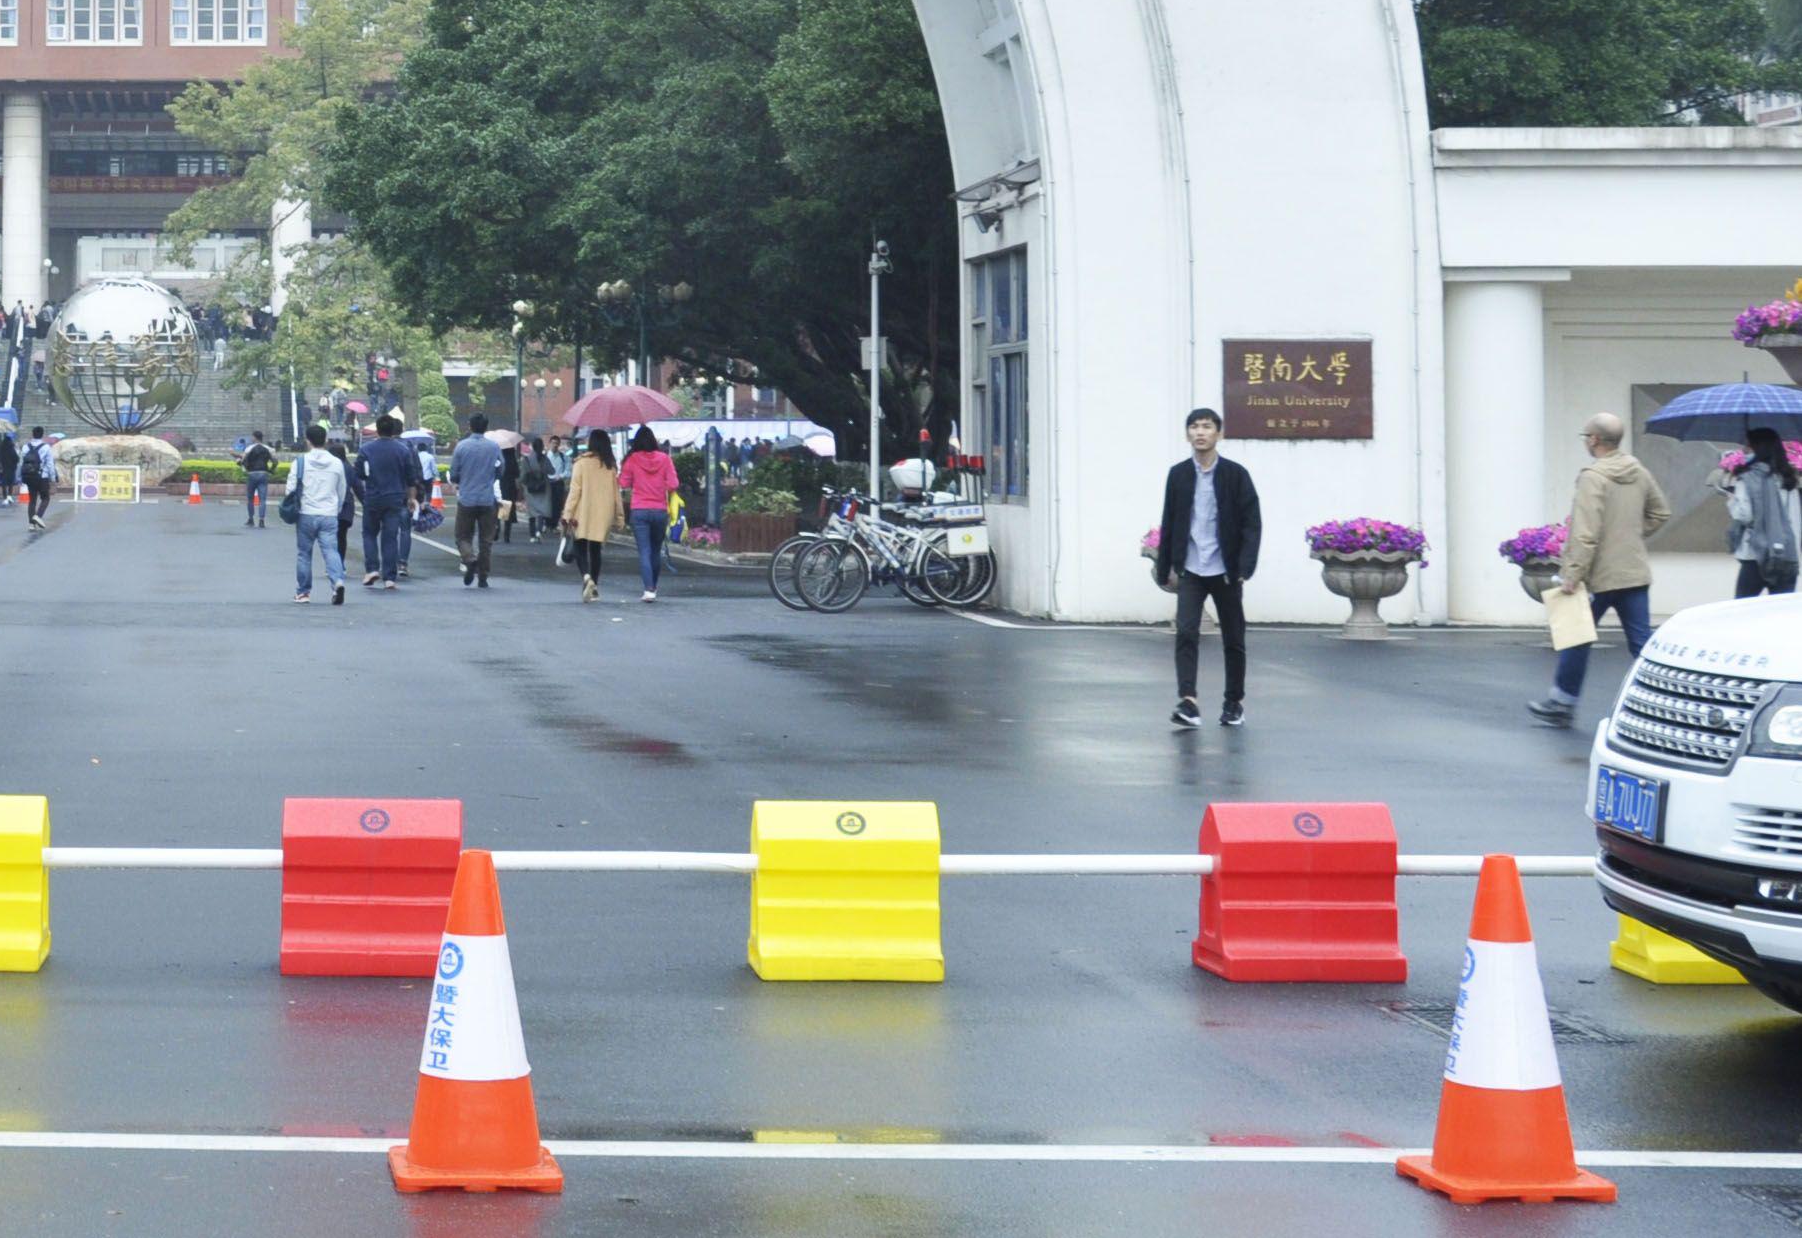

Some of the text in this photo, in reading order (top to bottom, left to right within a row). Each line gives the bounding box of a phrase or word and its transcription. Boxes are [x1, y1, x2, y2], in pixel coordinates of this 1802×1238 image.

[1246, 395, 1352, 409] Jinan University
[1696, 649, 1769, 667] ROVER
[426, 983, 459, 1071] 暨大保卫
